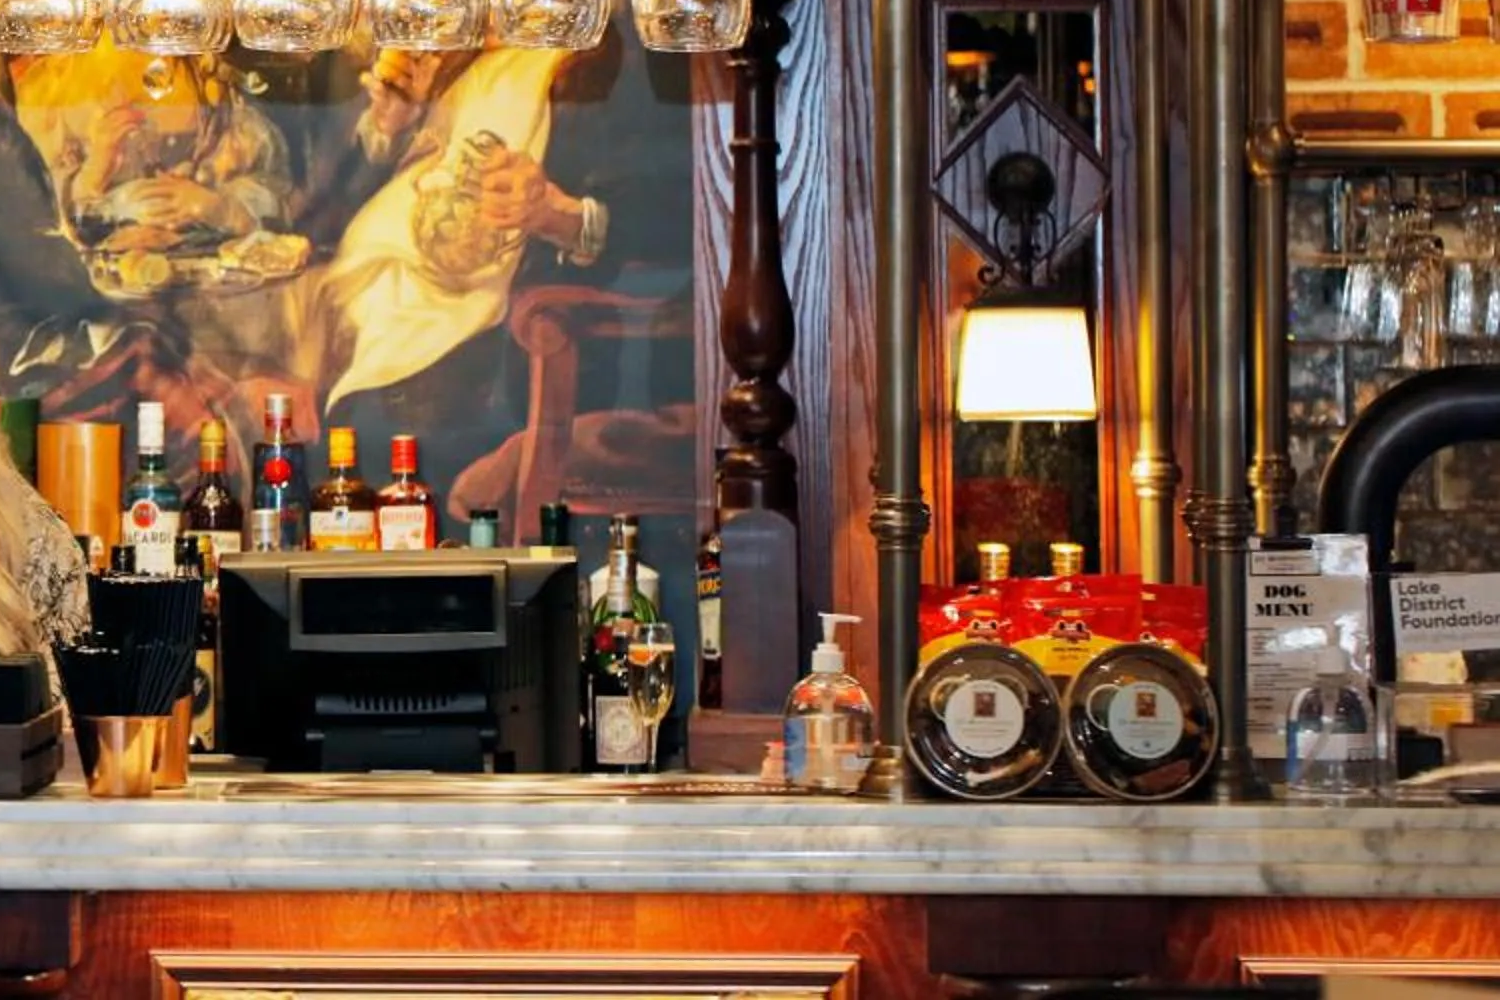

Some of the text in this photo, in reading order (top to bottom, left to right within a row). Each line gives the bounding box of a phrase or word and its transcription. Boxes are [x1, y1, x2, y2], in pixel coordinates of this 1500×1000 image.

[1264, 584, 1307, 598] DOG
[1397, 581, 1440, 595] Lake
[1255, 603, 1315, 617] MENU
[1400, 596, 1466, 612] District
